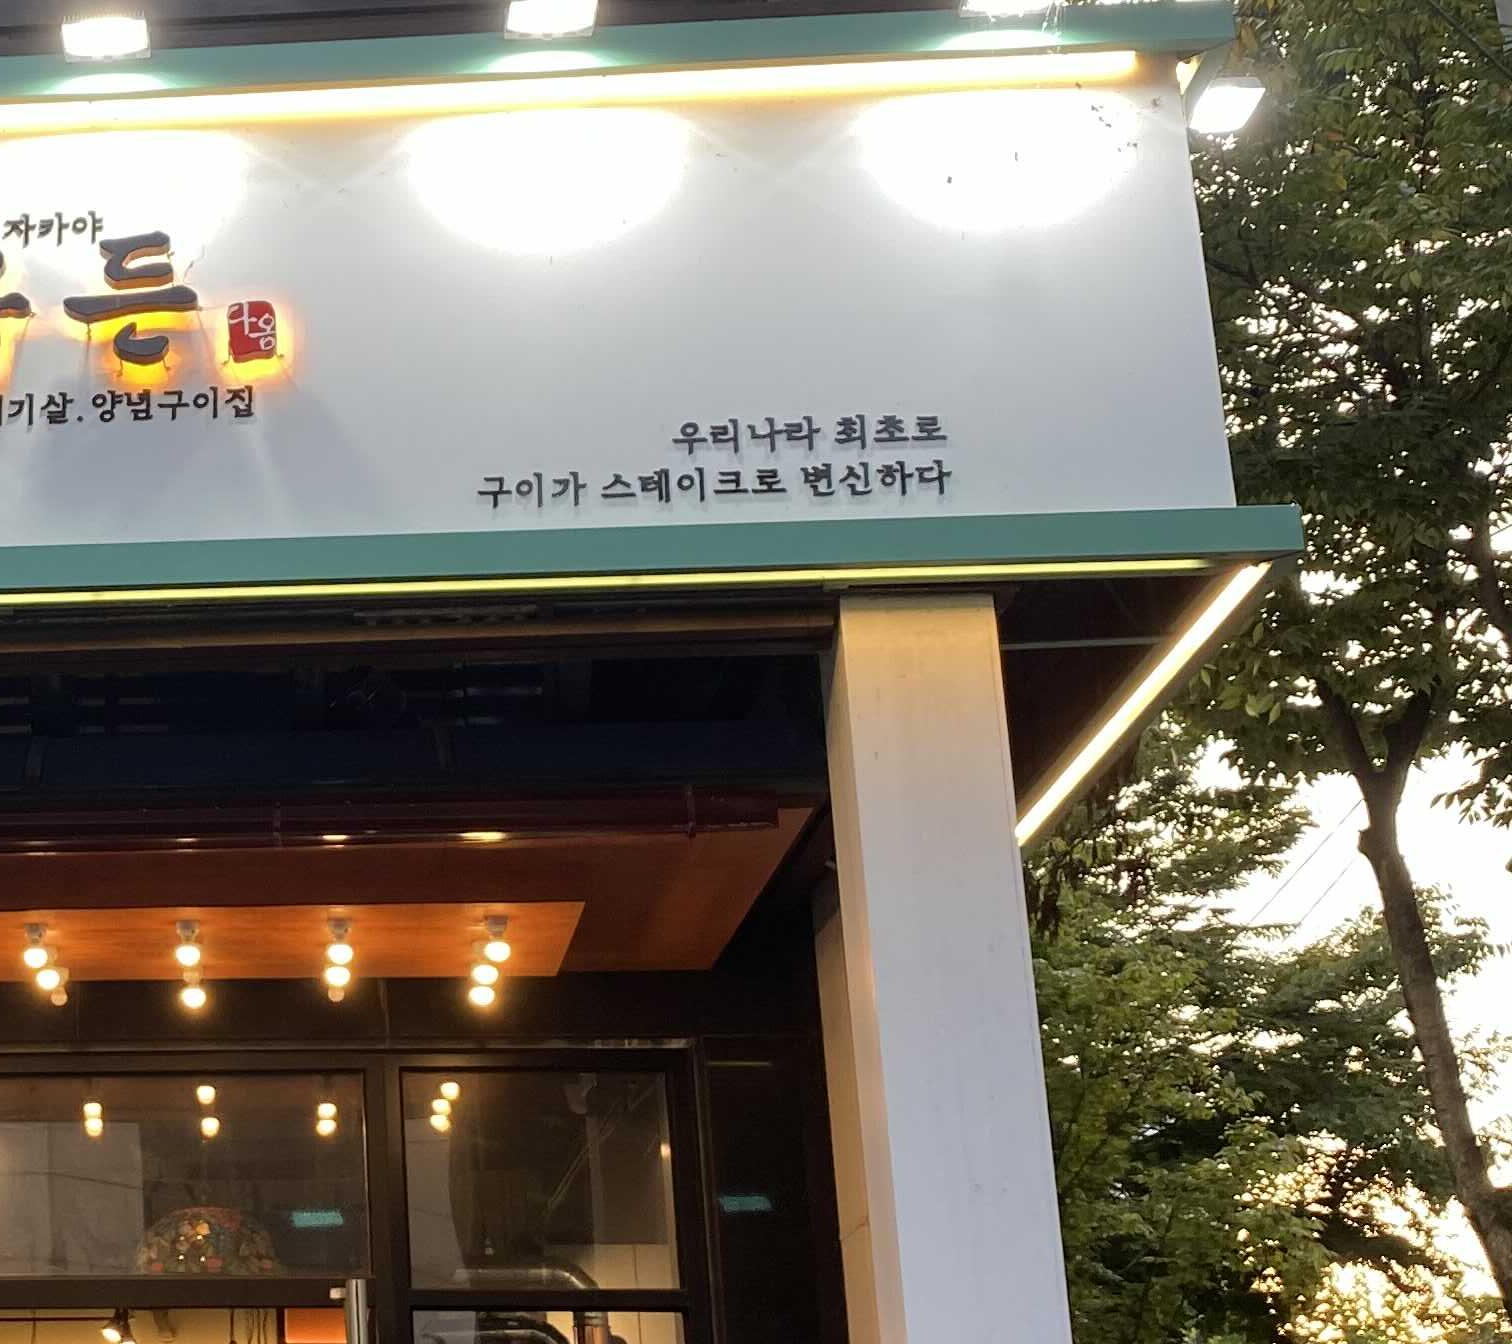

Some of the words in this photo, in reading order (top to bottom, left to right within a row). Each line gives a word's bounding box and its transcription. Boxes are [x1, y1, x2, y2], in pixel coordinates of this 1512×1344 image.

[91, 385, 255, 424] 양념구이집
[672, 415, 821, 455] 우리나라
[834, 413, 948, 449] 최초로
[477, 471, 587, 508] 구이가
[600, 466, 787, 503] 스테이크로
[800, 459, 953, 497] 변신하다
